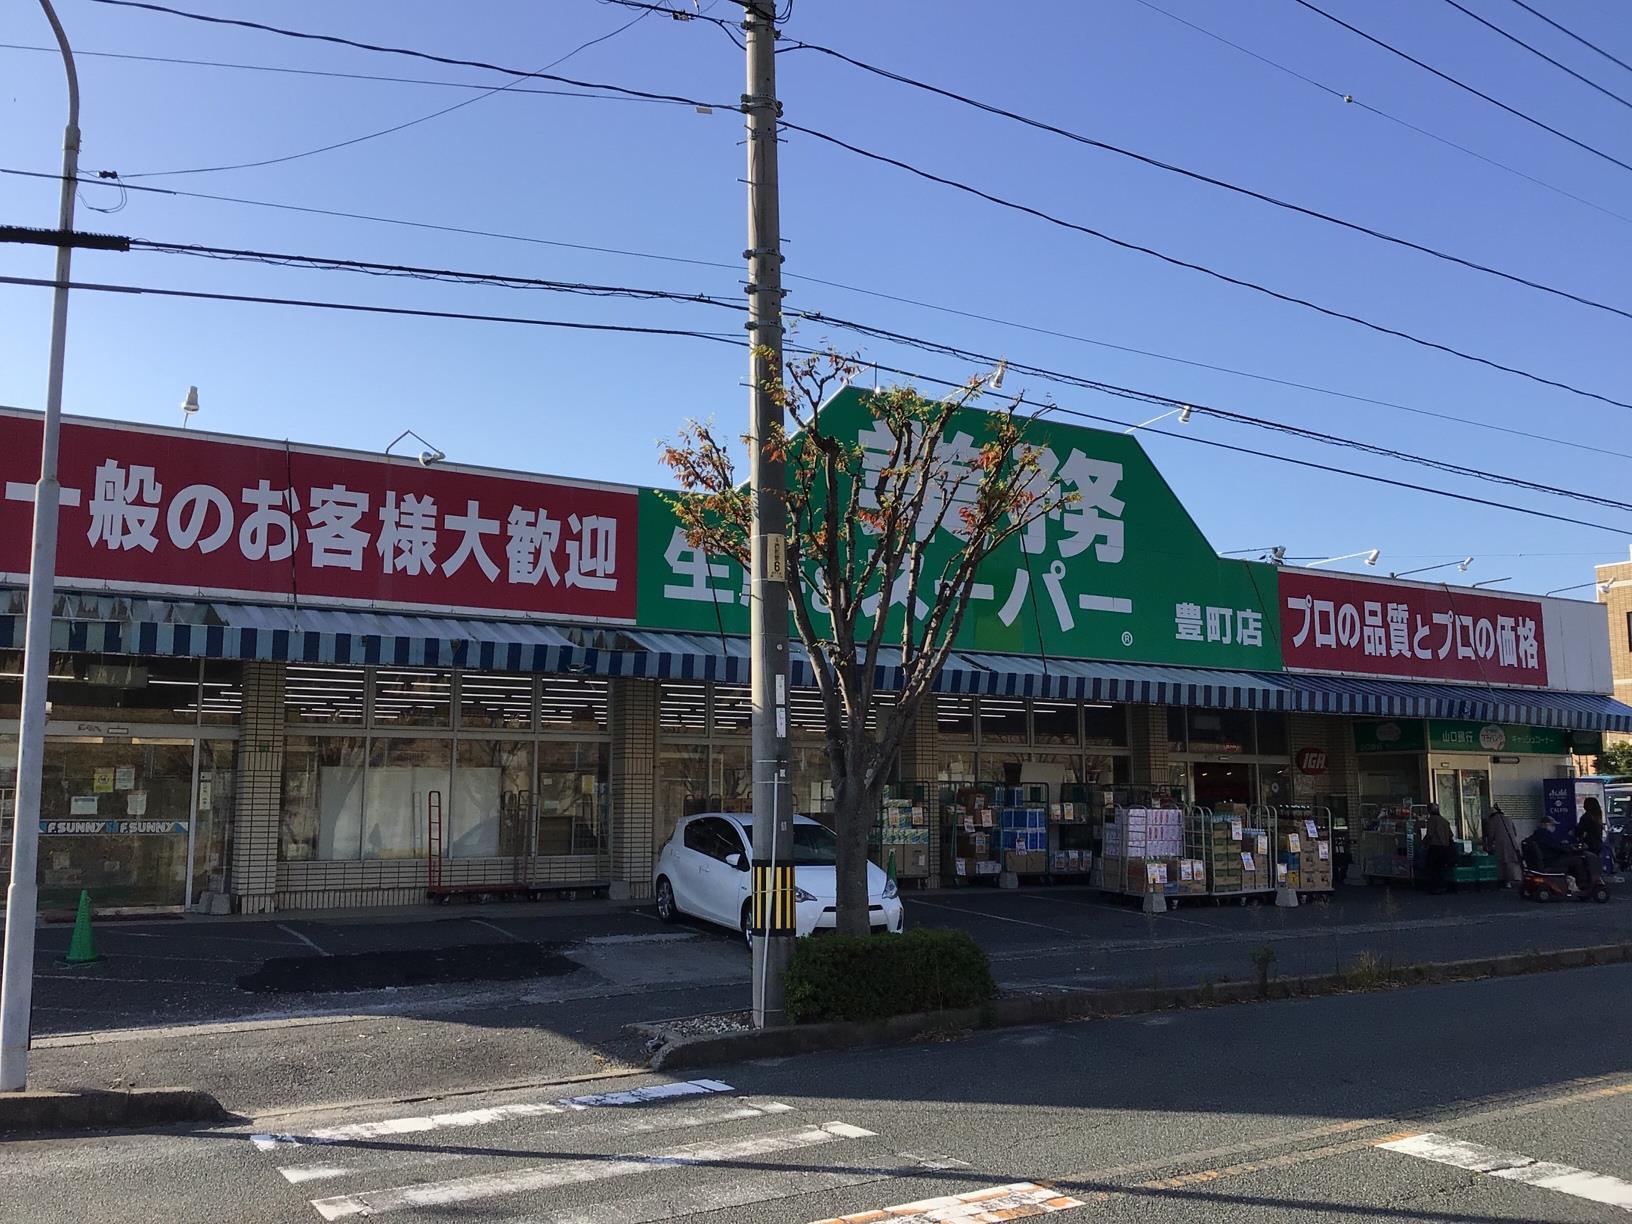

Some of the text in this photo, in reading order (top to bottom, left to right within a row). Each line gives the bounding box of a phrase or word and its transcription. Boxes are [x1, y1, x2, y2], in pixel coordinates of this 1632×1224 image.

[5, 458, 618, 592] 一般のお客様大歓迎
[1174, 602, 1264, 648] 豊町店
[1288, 594, 1539, 669] プロの品質とプロの価格
[1302, 752, 1327, 769] IGA
[47, 821, 174, 833] F.SUNNY F.SUNNY
